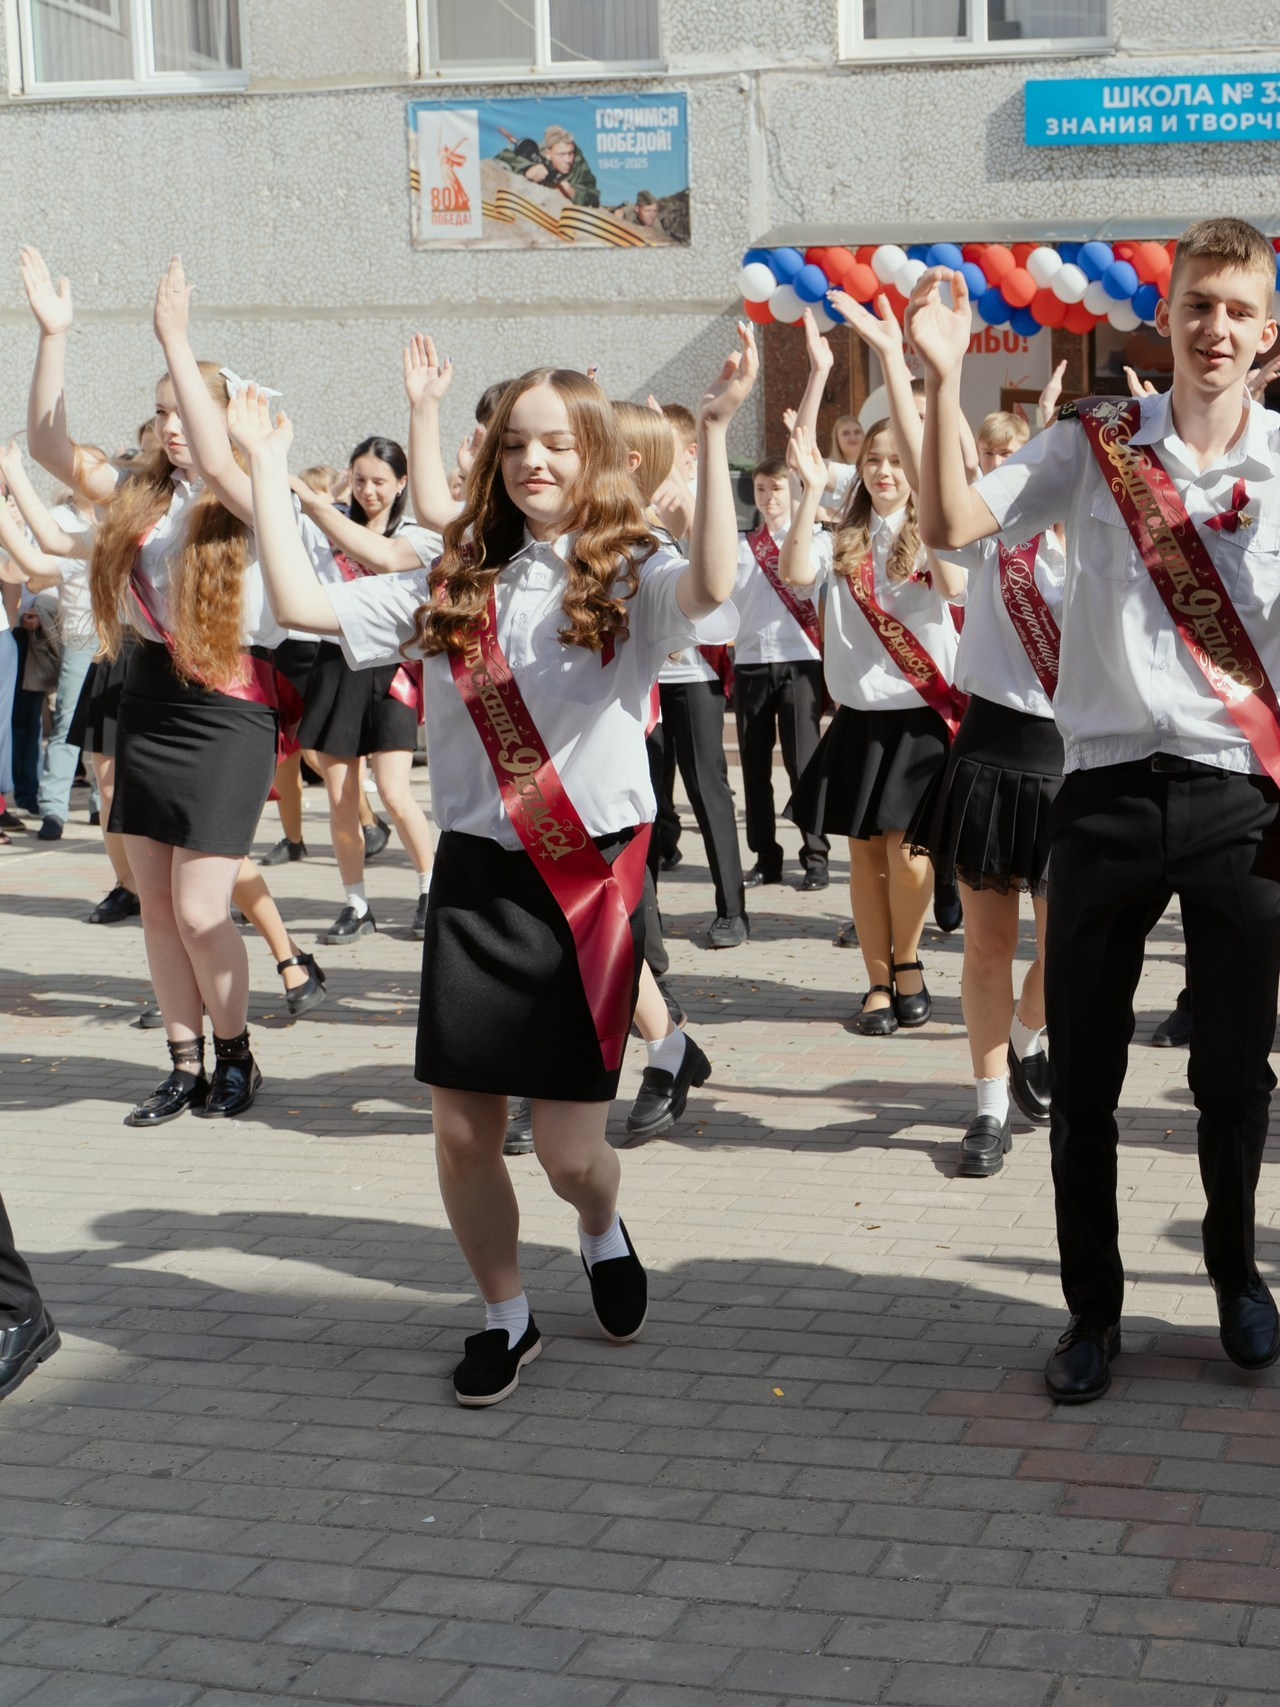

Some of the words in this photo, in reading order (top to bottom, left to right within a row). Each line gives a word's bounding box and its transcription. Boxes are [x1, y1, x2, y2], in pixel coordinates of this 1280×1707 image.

[1102, 83, 1214, 108] ШКОЛА
[1221, 82, 1254, 105] №
[595, 106, 679, 131] ГОРДИМСЯ
[1045, 115, 1153, 136] ЗНАНИЯ
[1161, 114, 1178, 132] И
[596, 128, 673, 155] ПОБЕДОЙ!
[431, 187, 452, 209] 80
[431, 212, 472, 227] ПОБЕДА!
[1172, 588, 1222, 616] 9
[879, 621, 905, 639] 9
[498, 747, 542, 774] 9
